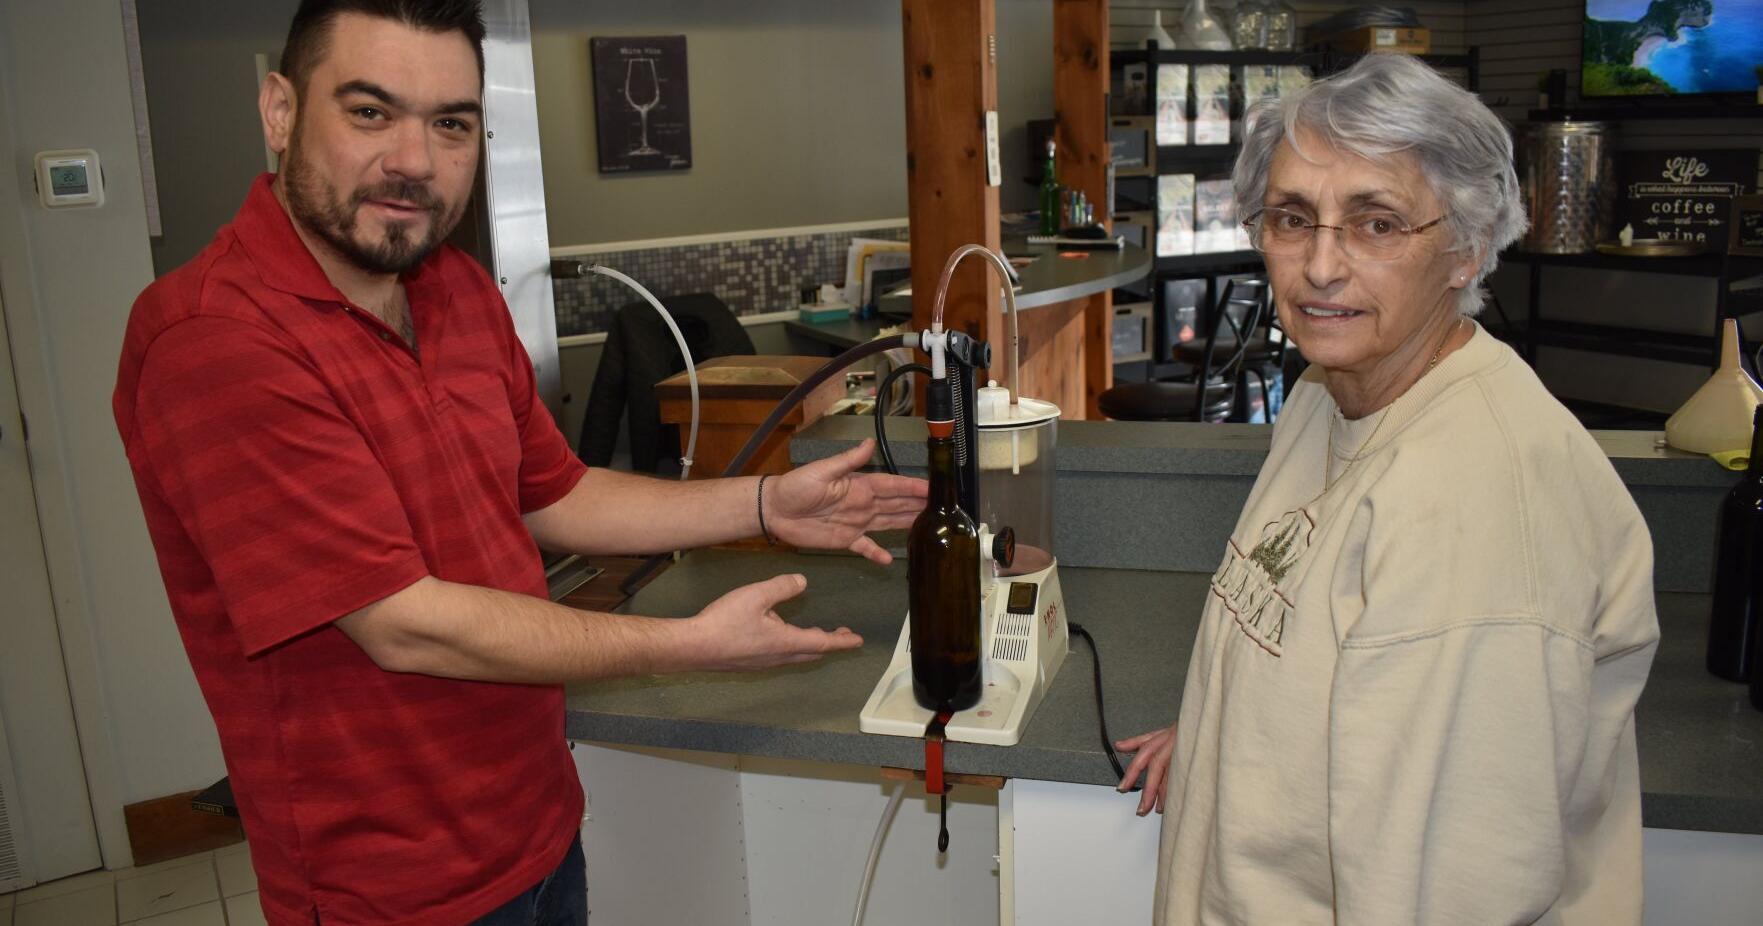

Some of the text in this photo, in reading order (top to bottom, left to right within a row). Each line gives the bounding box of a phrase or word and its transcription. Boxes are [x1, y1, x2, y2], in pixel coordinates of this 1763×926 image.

[1662, 157, 1709, 185] Life
[1651, 199, 1715, 214] coffee
[1657, 227, 1707, 242] wine
[1216, 554, 1286, 647] LASKA
